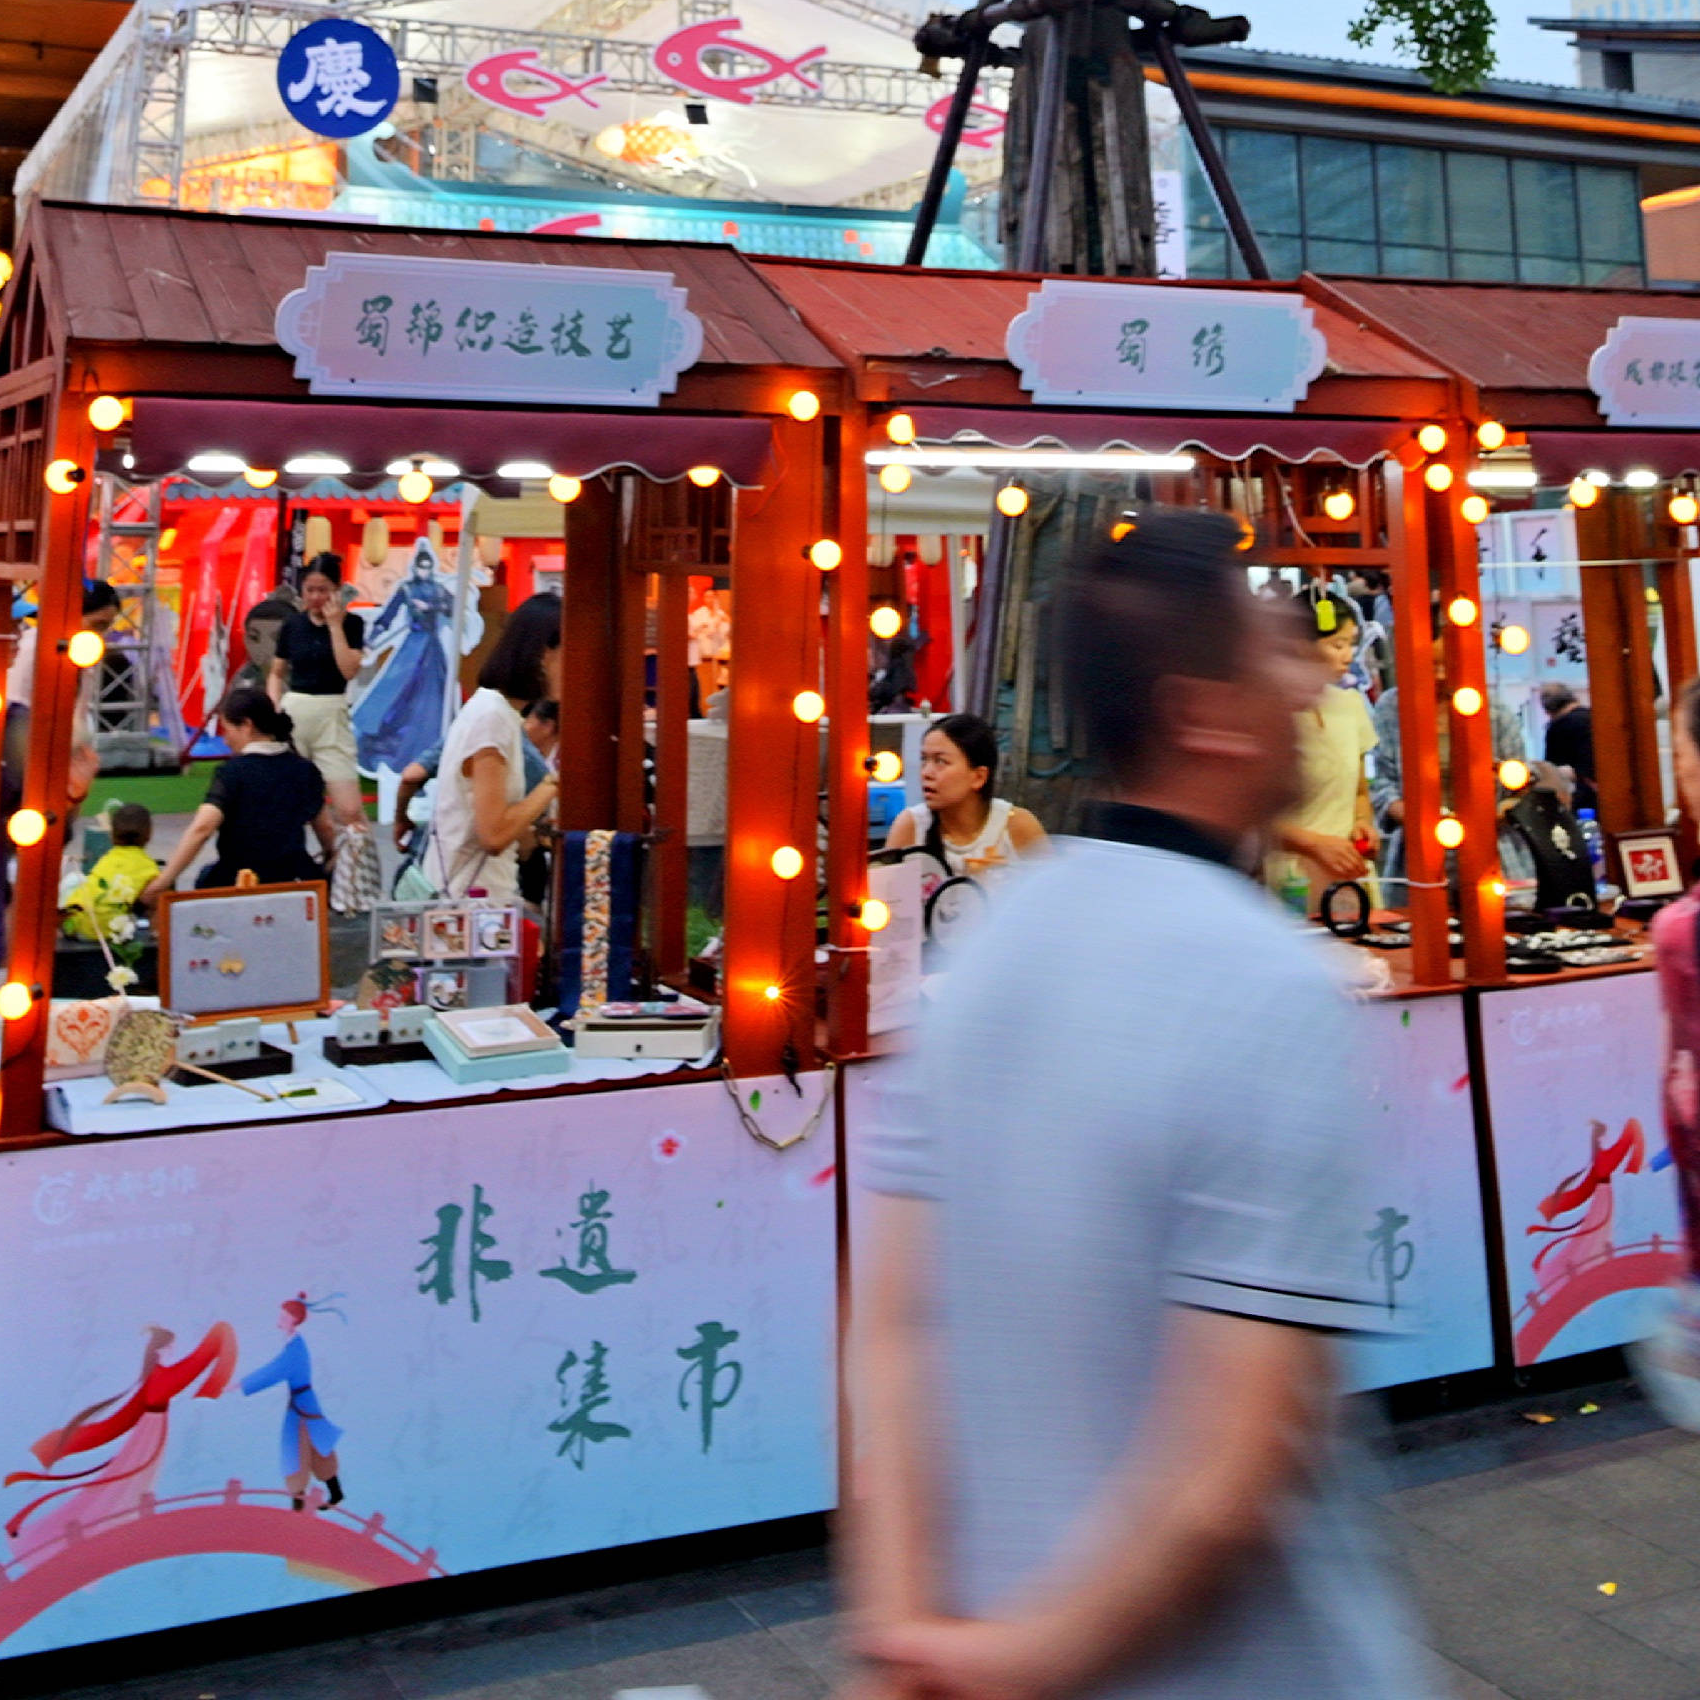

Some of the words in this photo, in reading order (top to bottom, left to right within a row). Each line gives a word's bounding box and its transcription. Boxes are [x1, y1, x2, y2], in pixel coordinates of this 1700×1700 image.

[288, 36, 387, 118] 慶
[356, 295, 633, 361] 蜀锦织造技艺
[1116, 318, 1225, 376] 蜀绣
[414, 1181, 637, 1322] 非遗
[547, 1320, 744, 1471] 集市
